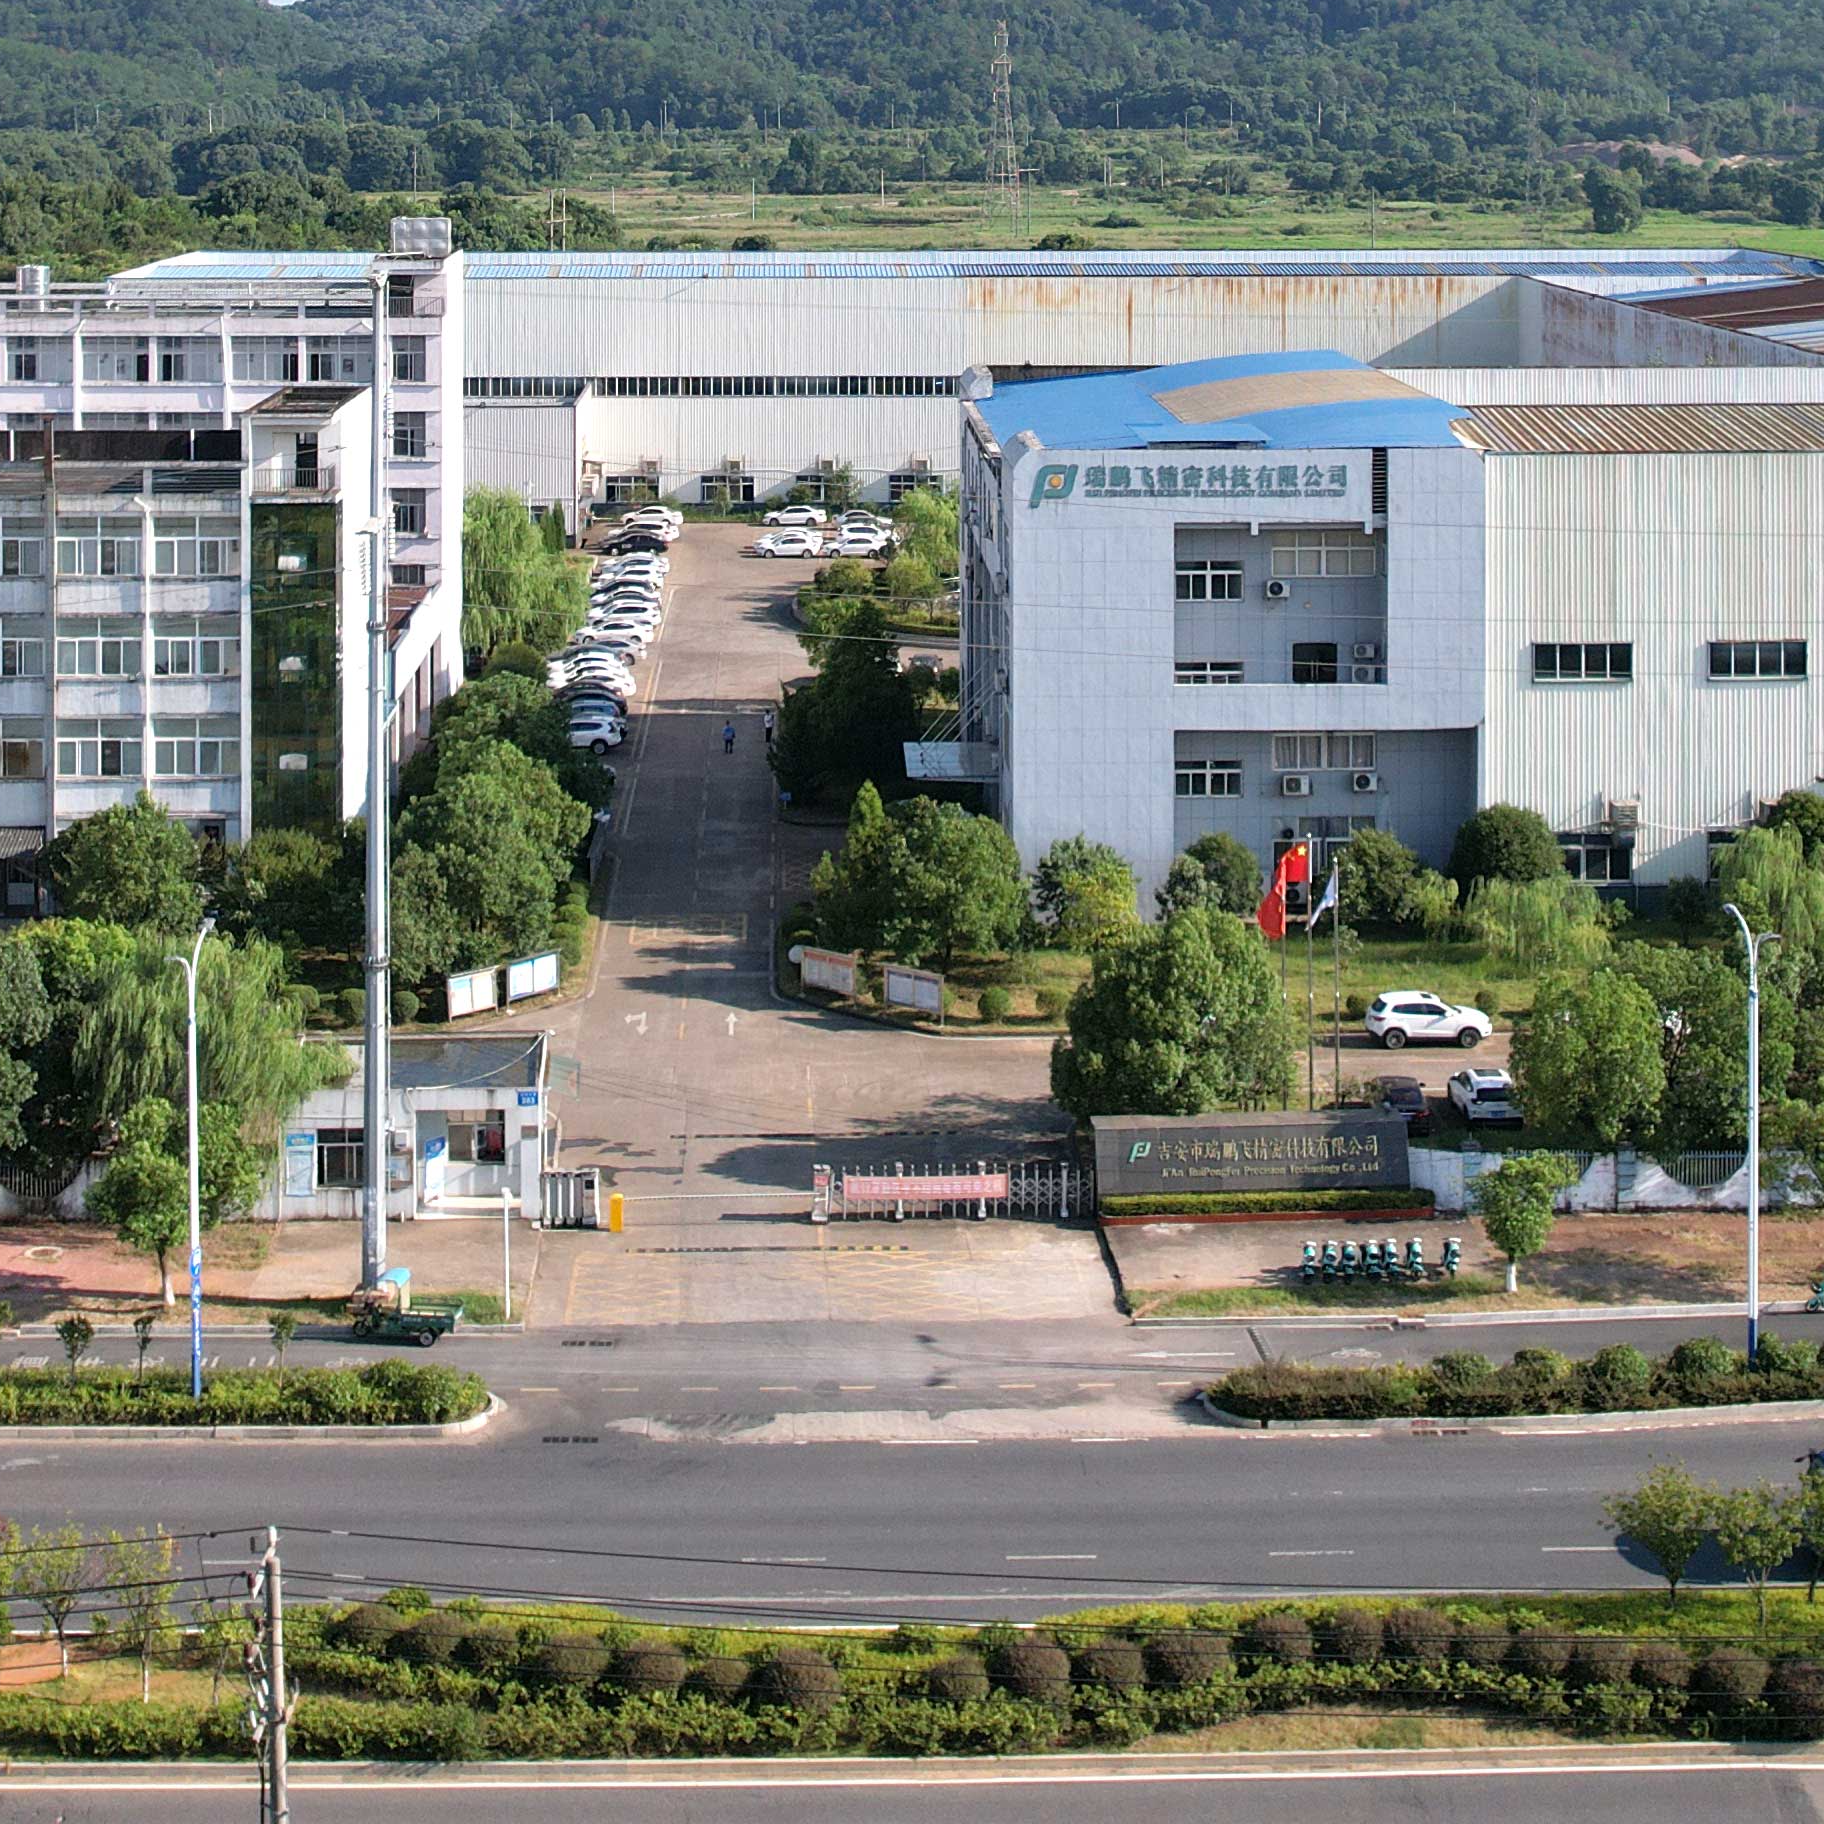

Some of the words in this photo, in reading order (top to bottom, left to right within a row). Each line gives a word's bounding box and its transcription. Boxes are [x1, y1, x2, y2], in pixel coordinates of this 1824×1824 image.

[1083, 464, 1348, 488] 瑞鹏飞精密科技有限公司
[1158, 1135, 1378, 1163] 吉安市瑞鹏飞精密科技有限公司
[1243, 1165, 1286, 1177] Precision
[1289, 1163, 1341, 1175] Technology
